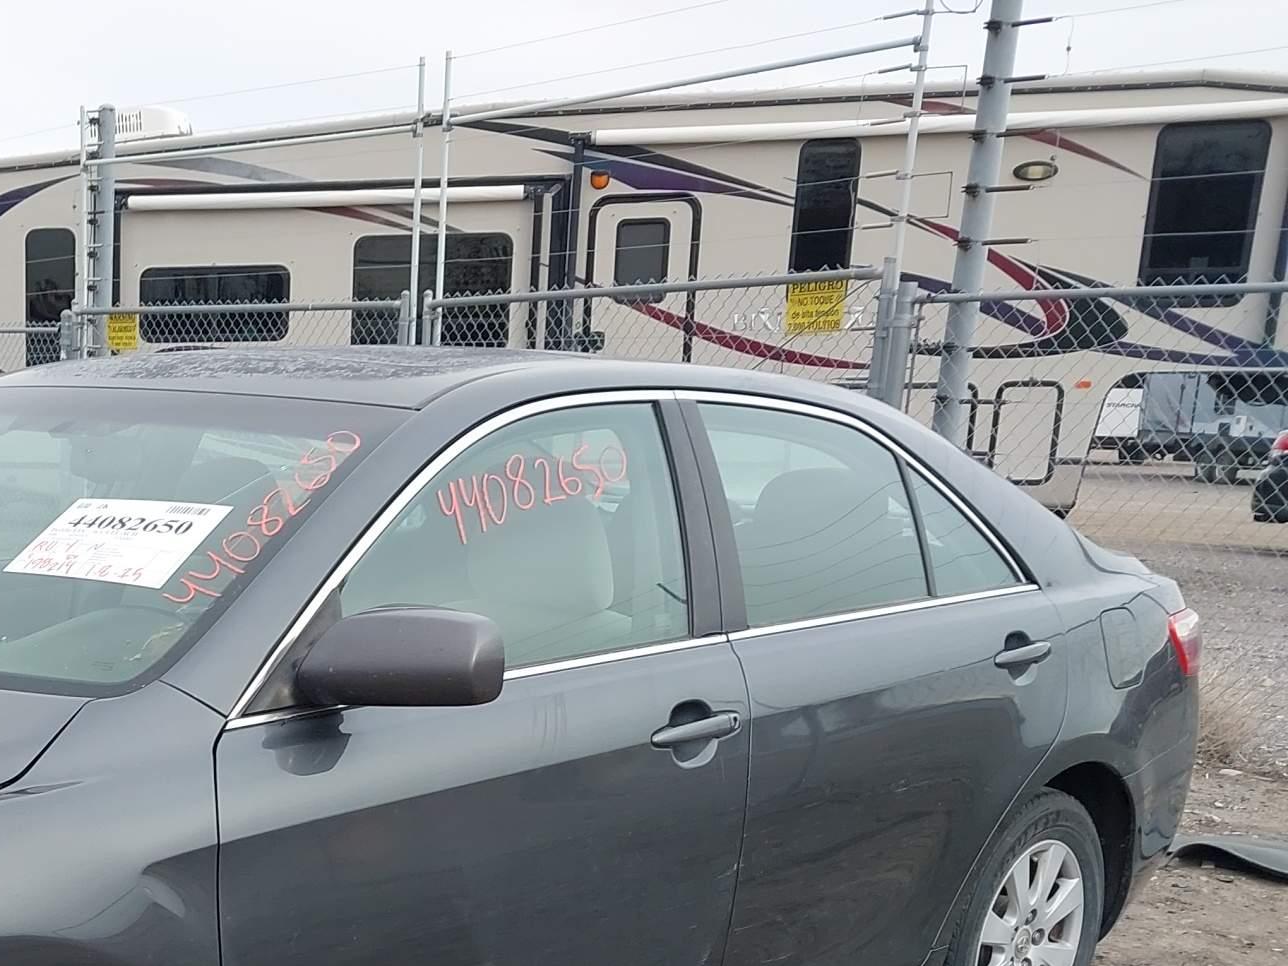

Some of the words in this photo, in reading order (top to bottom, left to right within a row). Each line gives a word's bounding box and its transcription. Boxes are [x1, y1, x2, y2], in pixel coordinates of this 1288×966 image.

[791, 280, 844, 293] PELIGRO
[68, 514, 194, 536] 44082650
[163, 430, 361, 603] 44082650
[436, 443, 627, 545] 44082650
